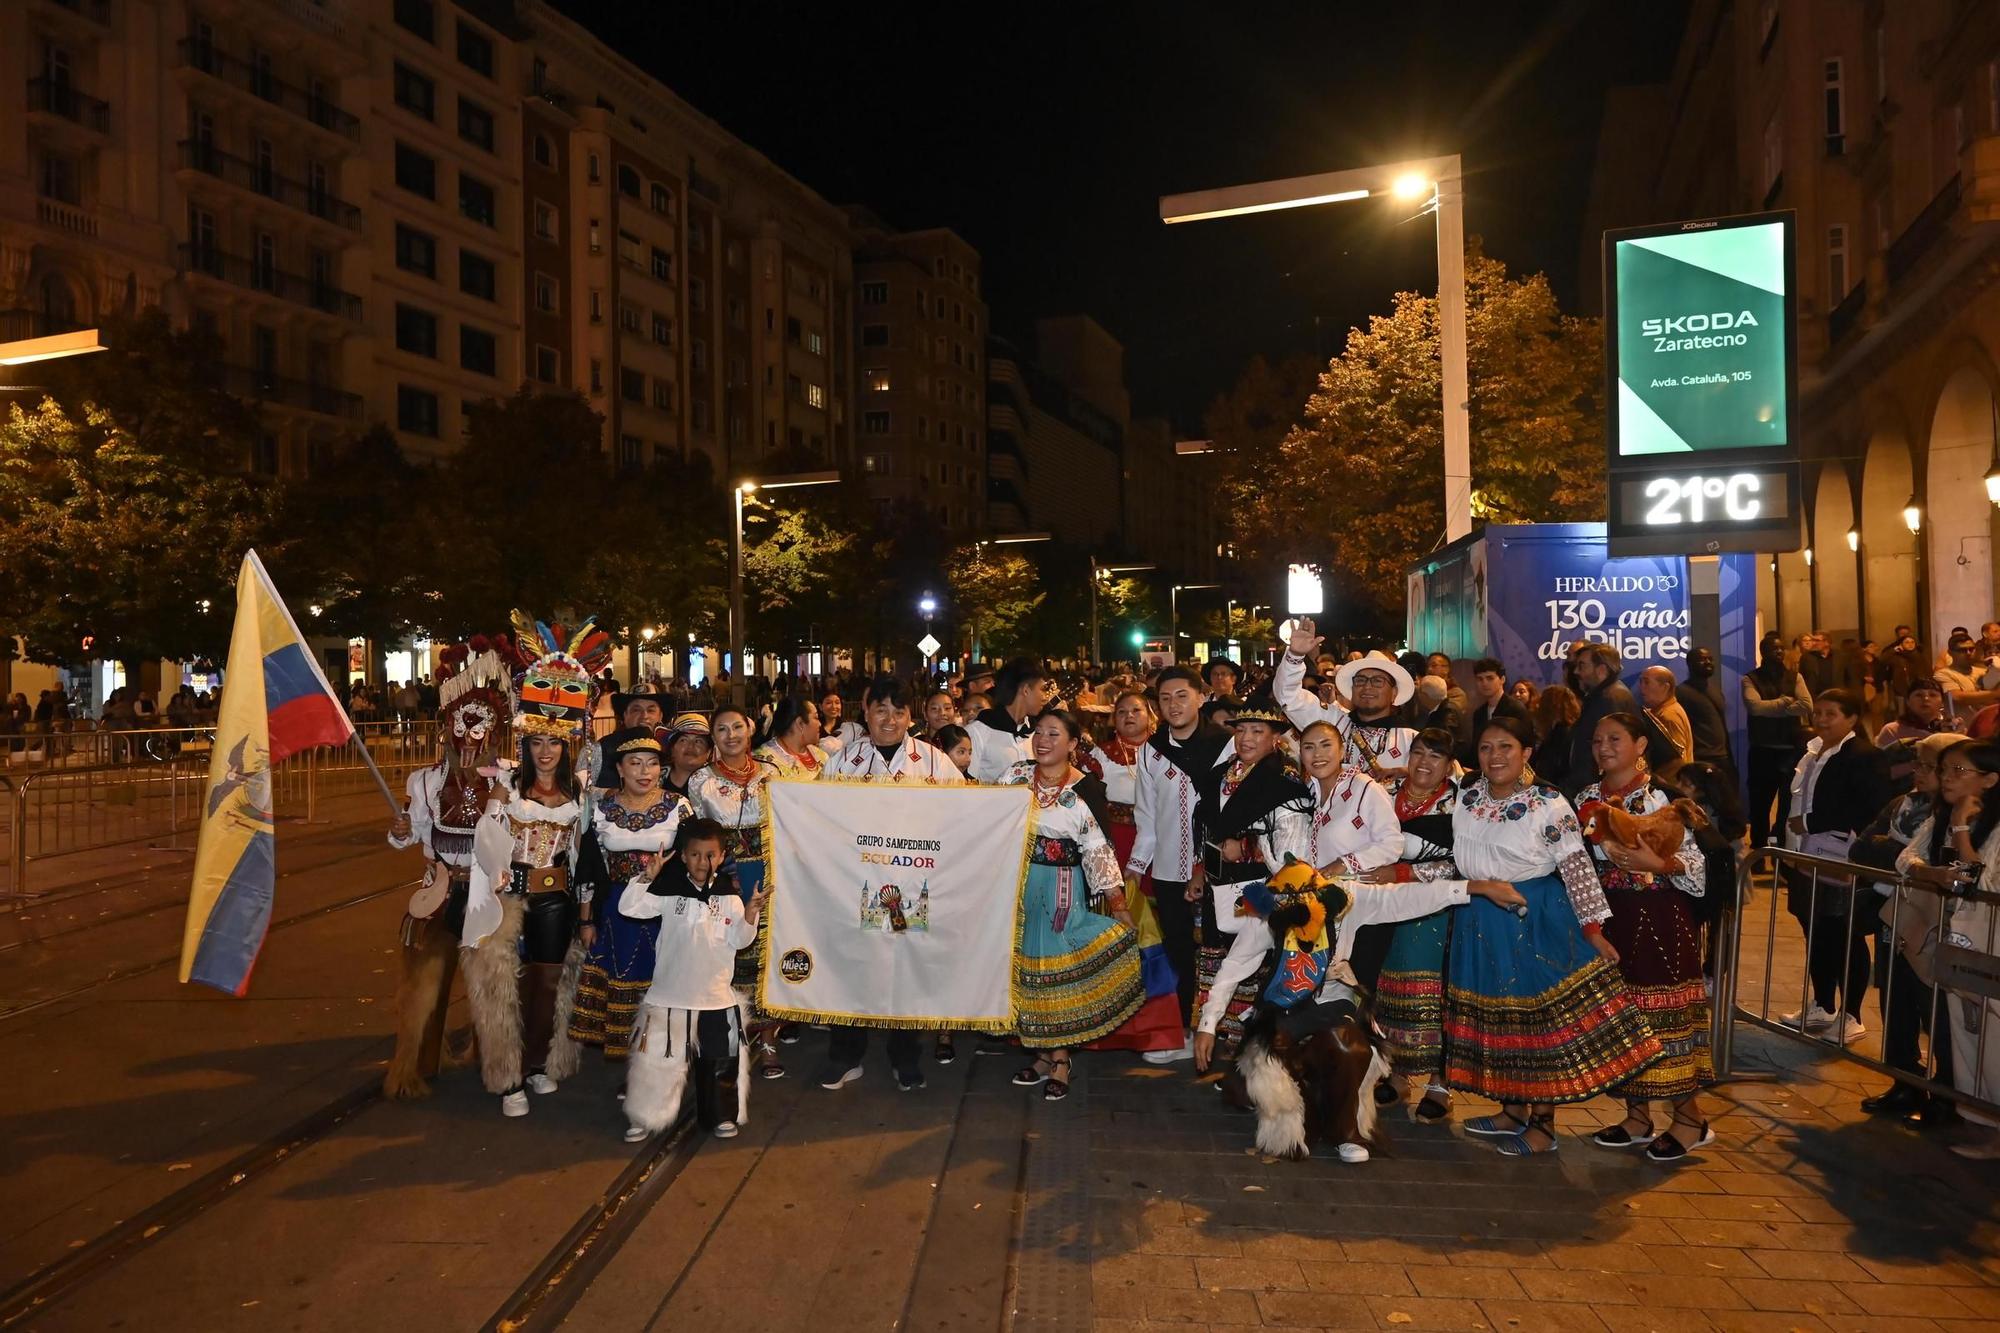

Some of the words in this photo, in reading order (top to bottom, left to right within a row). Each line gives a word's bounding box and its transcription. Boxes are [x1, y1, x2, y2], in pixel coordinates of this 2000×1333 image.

[1654, 333, 1747, 352] Zaratecno
[1650, 378, 1679, 388] Avda.
[1681, 373, 1730, 385] Cataluña,
[1732, 370, 1752, 381] 105
[1645, 473, 1760, 525] 21°C
[1555, 576, 1654, 593] HERALDO
[1545, 599, 1606, 630] 130
[1618, 602, 1690, 629] años
[1538, 630, 1572, 660] de
[857, 835, 883, 847] GRUPO
[886, 837, 941, 851] SAMPEDRINOS
[860, 852, 935, 868] ECUADOR
